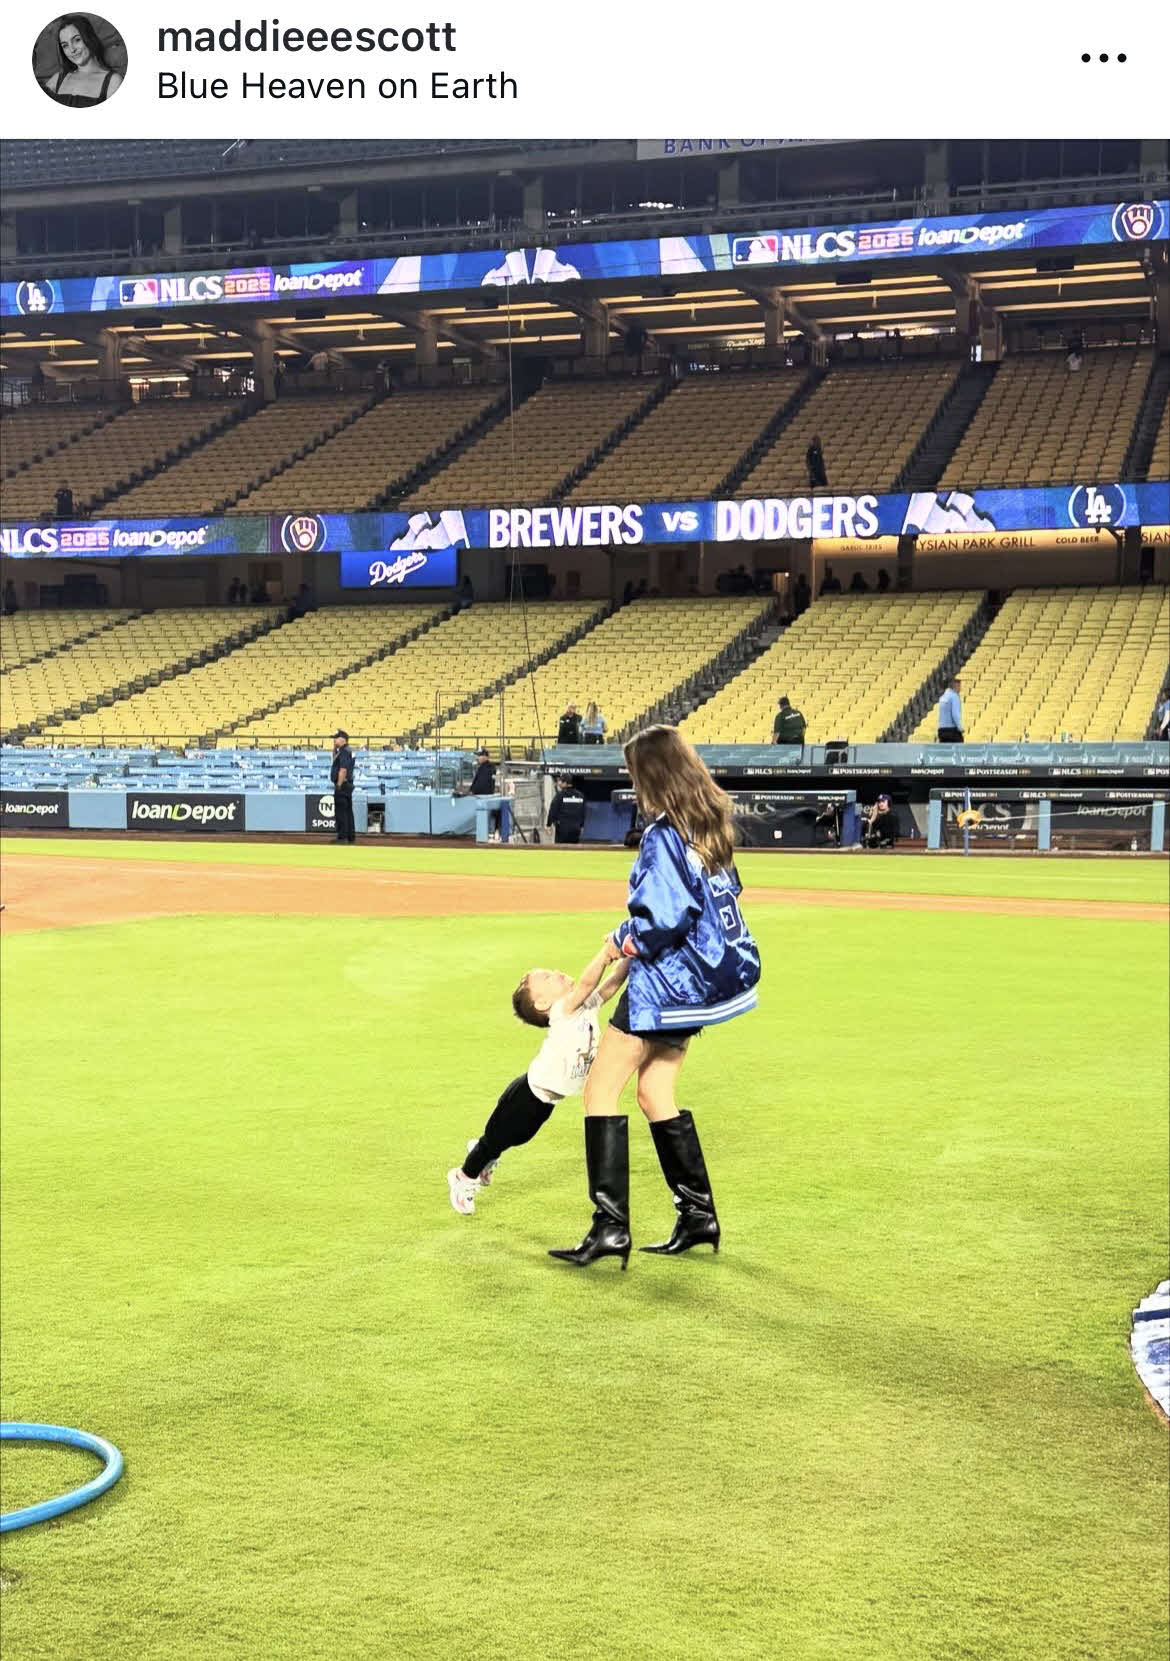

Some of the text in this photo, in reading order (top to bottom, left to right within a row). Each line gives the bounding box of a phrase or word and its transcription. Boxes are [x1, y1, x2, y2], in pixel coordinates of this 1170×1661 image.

[781, 222, 1026, 261] NLCS 2025 loanDepot
[160, 275, 223, 301] NLCS
[274, 268, 364, 292] loanDepot
[488, 503, 645, 549] BREWERS
[715, 494, 880, 542] DODGERS
[112, 528, 207, 550] loanDepot
[963, 537, 996, 550] PARK
[1000, 536, 1036, 549] GRILL
[1055, 534, 1100, 545] COLD BEER
[369, 552, 428, 586] Dodgers
[4, 802, 60, 817] loanDepot
[132, 799, 237, 825] loanDepot
[946, 802, 1011, 822] NCS
[312, 819, 337, 829] SPOR
